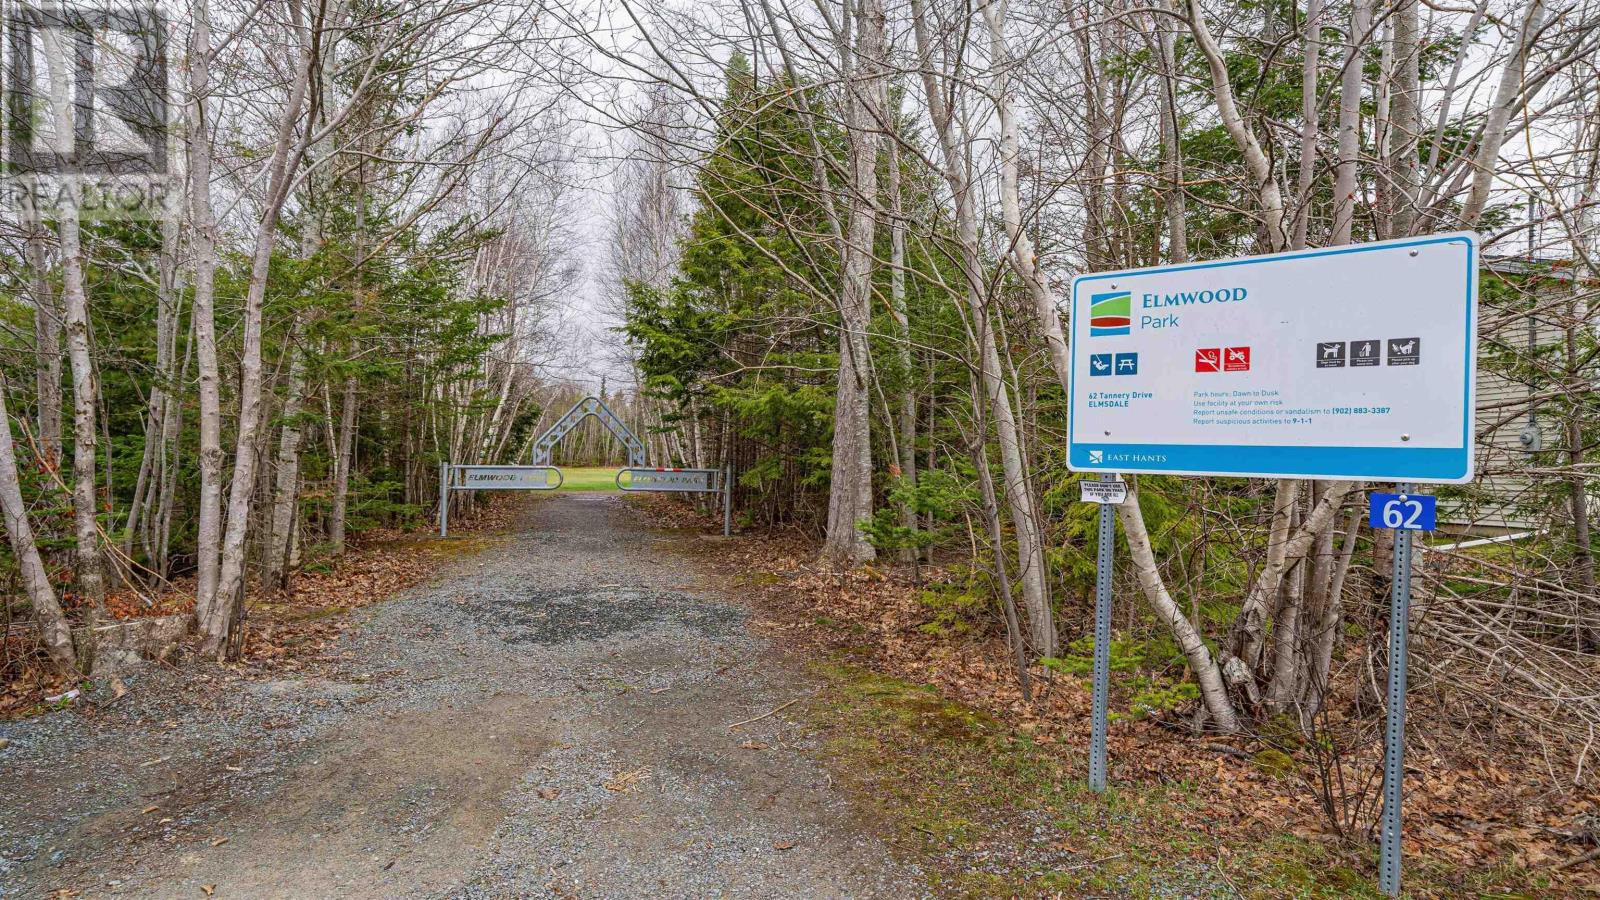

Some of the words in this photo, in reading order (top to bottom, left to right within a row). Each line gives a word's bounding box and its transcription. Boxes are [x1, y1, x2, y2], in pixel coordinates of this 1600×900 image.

[1142, 287, 1248, 309] ELMWOOD
[1141, 314, 1180, 329] Park
[1100, 392, 1130, 400] Tannery
[1132, 391, 1153, 399] Drive
[1261, 389, 1279, 397] Dusk
[1088, 400, 1129, 408] ELMSDALE
[1207, 400, 1229, 408] facility
[1238, 400, 1253, 408] your
[1193, 409, 1215, 417] Report
[1332, 407, 1352, 415] (902)
[1193, 418, 1214, 426] Report
[1215, 418, 1251, 426] suspicious
[1292, 417, 1312, 425] 9-1-1
[1132, 454, 1168, 462] HANTS
[1383, 500, 1423, 529] 62
